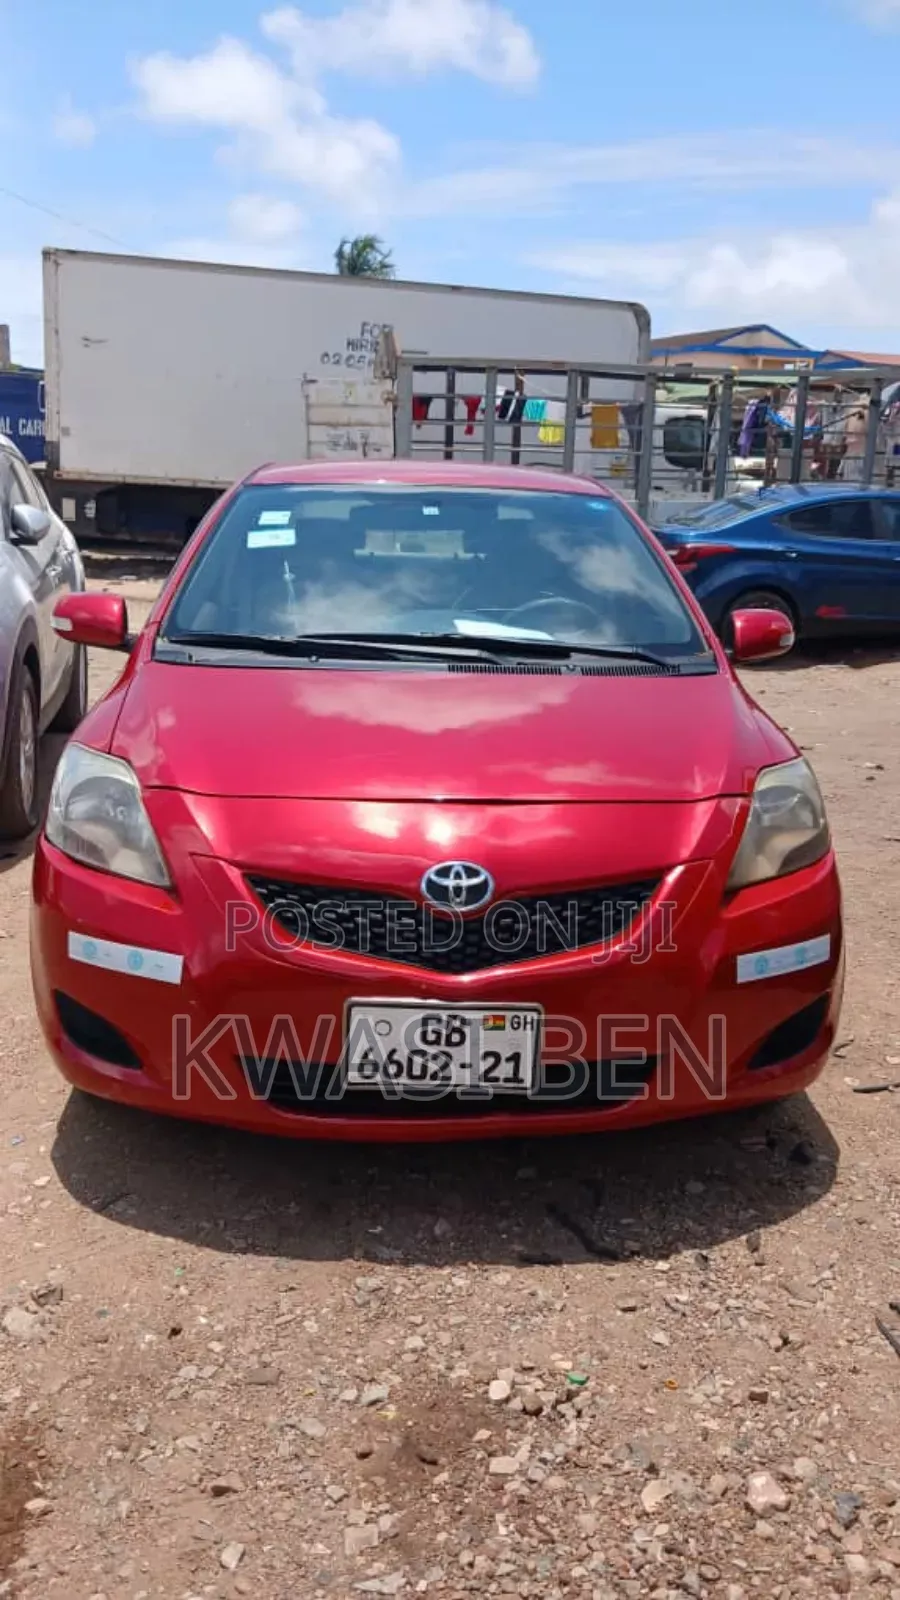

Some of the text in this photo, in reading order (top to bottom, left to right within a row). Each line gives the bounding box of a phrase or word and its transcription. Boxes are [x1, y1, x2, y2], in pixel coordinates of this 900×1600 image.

[19, 418, 45, 436] CAR
[420, 1013, 468, 1048] GB
[509, 1014, 535, 1031] GH
[356, 1047, 525, 1084] 6602-21
